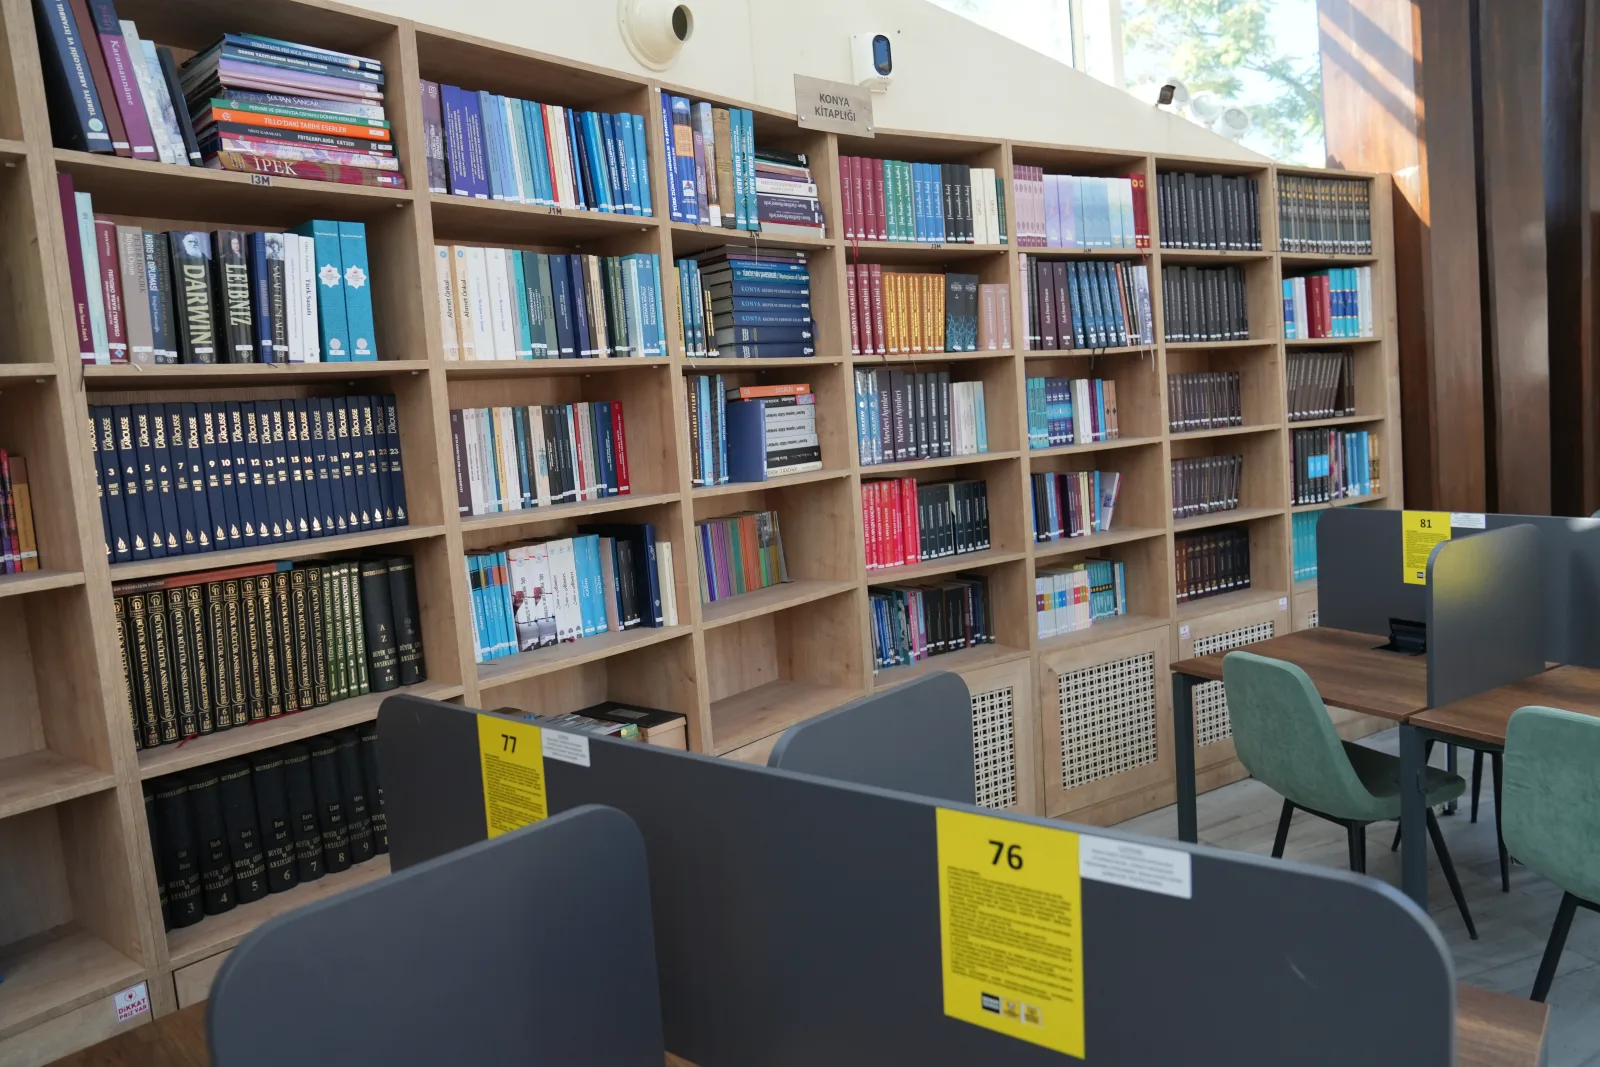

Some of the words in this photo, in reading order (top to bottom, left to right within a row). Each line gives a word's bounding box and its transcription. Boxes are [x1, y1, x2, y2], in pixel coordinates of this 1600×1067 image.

[57, 3, 70, 35] İSTANBUL
[70, 46, 88, 88] ARKEOLOJİSİ
[111, 40, 133, 105] Karamannâme
[84, 89, 96, 115] TÜRKİYE
[815, 105, 856, 122] KİTAPLIĞI
[820, 93, 849, 107] KONYA
[264, 117, 298, 129] TİLLO'DAKİ
[321, 124, 346, 133] ESERLER
[254, 155, 297, 175] İPEK
[145, 234, 154, 253] KIBRIS
[148, 261, 158, 291] DİPLOMASİ
[183, 264, 212, 344] DARWIN
[226, 264, 252, 326] LEIBNIZ
[848, 288, 857, 310] TARİHİ
[874, 288, 882, 309] TARİHİ
[121, 417, 132, 450] LAROUSSE
[139, 415, 150, 447] LAROUSSE
[155, 416, 166, 449] LAROUSSE
[173, 414, 183, 446] LAROUSSE
[189, 417, 199, 449] LAROUSSE
[204, 413, 215, 444] LAROUSSE
[218, 412, 228, 444] LAROUSSE
[233, 411, 243, 442] LAROUSSE
[248, 412, 258, 444] LAROUSSE
[262, 414, 271, 444] LAROUSSE
[274, 411, 283, 441] LAROUSSE
[287, 410, 297, 441] LAROUSSE
[300, 411, 310, 441] LAROUSSE
[314, 410, 323, 440] LAROUSSE
[326, 411, 336, 440] LAROUSSE
[338, 408, 348, 437] LAROUSSE
[351, 408, 360, 437] LAROUSSE
[364, 407, 373, 435] LAROUSSE
[376, 406, 385, 434] LAROUSSE
[388, 406, 396, 434] LAROUSSE
[882, 418, 891, 443] Mevlevi
[103, 418, 114, 451] LAROUSSE
[1420, 518, 1432, 528] 81
[247, 599, 255, 623] BÜYÜK
[262, 596, 272, 619] BÜYÜK
[279, 593, 288, 616] BÜYÜK
[295, 590, 304, 613] BÜYÜK
[310, 589, 319, 611] BÜYÜK
[154, 614, 163, 639] BÜYÜK
[174, 610, 183, 635] BÜYÜK
[192, 608, 201, 632] BÜYÜK
[213, 603, 222, 628] BÜYÜK
[228, 602, 237, 626] BÜYÜK
[297, 614, 306, 639] KÜLTÜR
[312, 612, 321, 637] KÜLTÜR
[135, 618, 145, 643] BÜYÜK
[215, 628, 224, 655] KÜLTÜR
[230, 626, 239, 653] KÜLTÜR
[249, 623, 257, 650] KÜLTÜR
[264, 620, 275, 647] KÜLTÜR
[281, 617, 291, 643] KÜLTÜR
[138, 644, 149, 672] KÜLTÜR
[156, 639, 167, 668] KÜLTÜR
[176, 635, 186, 663] KÜLTÜR
[195, 632, 205, 660] KÜLTÜR
[501, 734, 517, 754] 77
[339, 853, 344, 862] 8
[363, 842, 368, 851] 9
[988, 839, 1023, 870] 76
[284, 869, 290, 880] 6
[311, 861, 317, 871] 7
[221, 893, 227, 903] 4
[252, 881, 258, 891] 5
[188, 903, 194, 913] 3
[118, 998, 146, 1014] DİKKAT
[135, 1004, 147, 1013] VAR
